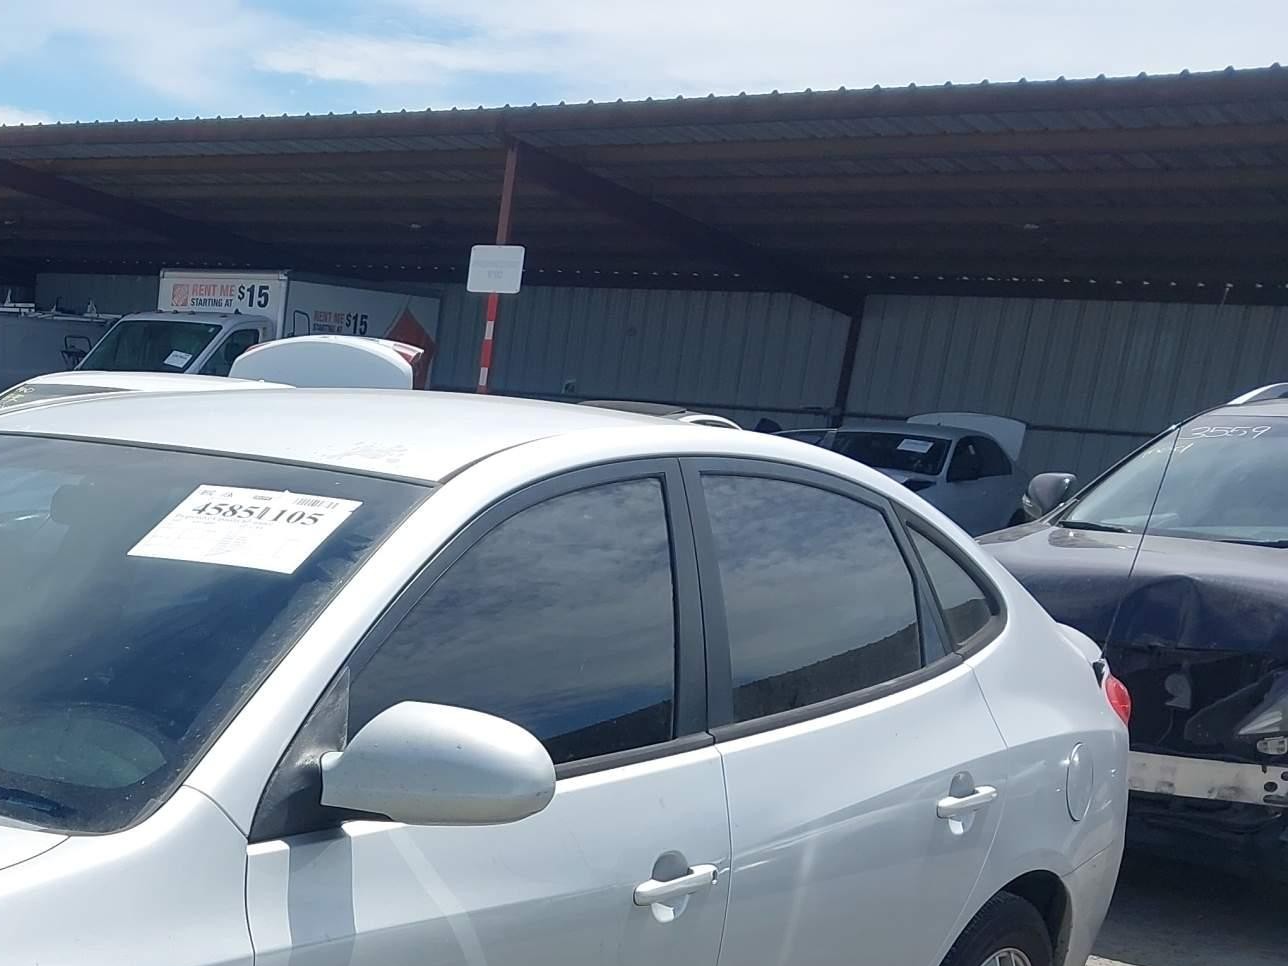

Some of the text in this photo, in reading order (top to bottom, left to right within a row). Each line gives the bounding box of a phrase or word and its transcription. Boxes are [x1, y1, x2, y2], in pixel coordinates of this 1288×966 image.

[192, 283, 217, 296] RENT
[219, 285, 235, 297] ME
[238, 284, 270, 309] $15
[191, 297, 233, 308] STARTING AT
[345, 312, 369, 336] $15
[192, 502, 324, 526] 45851105
